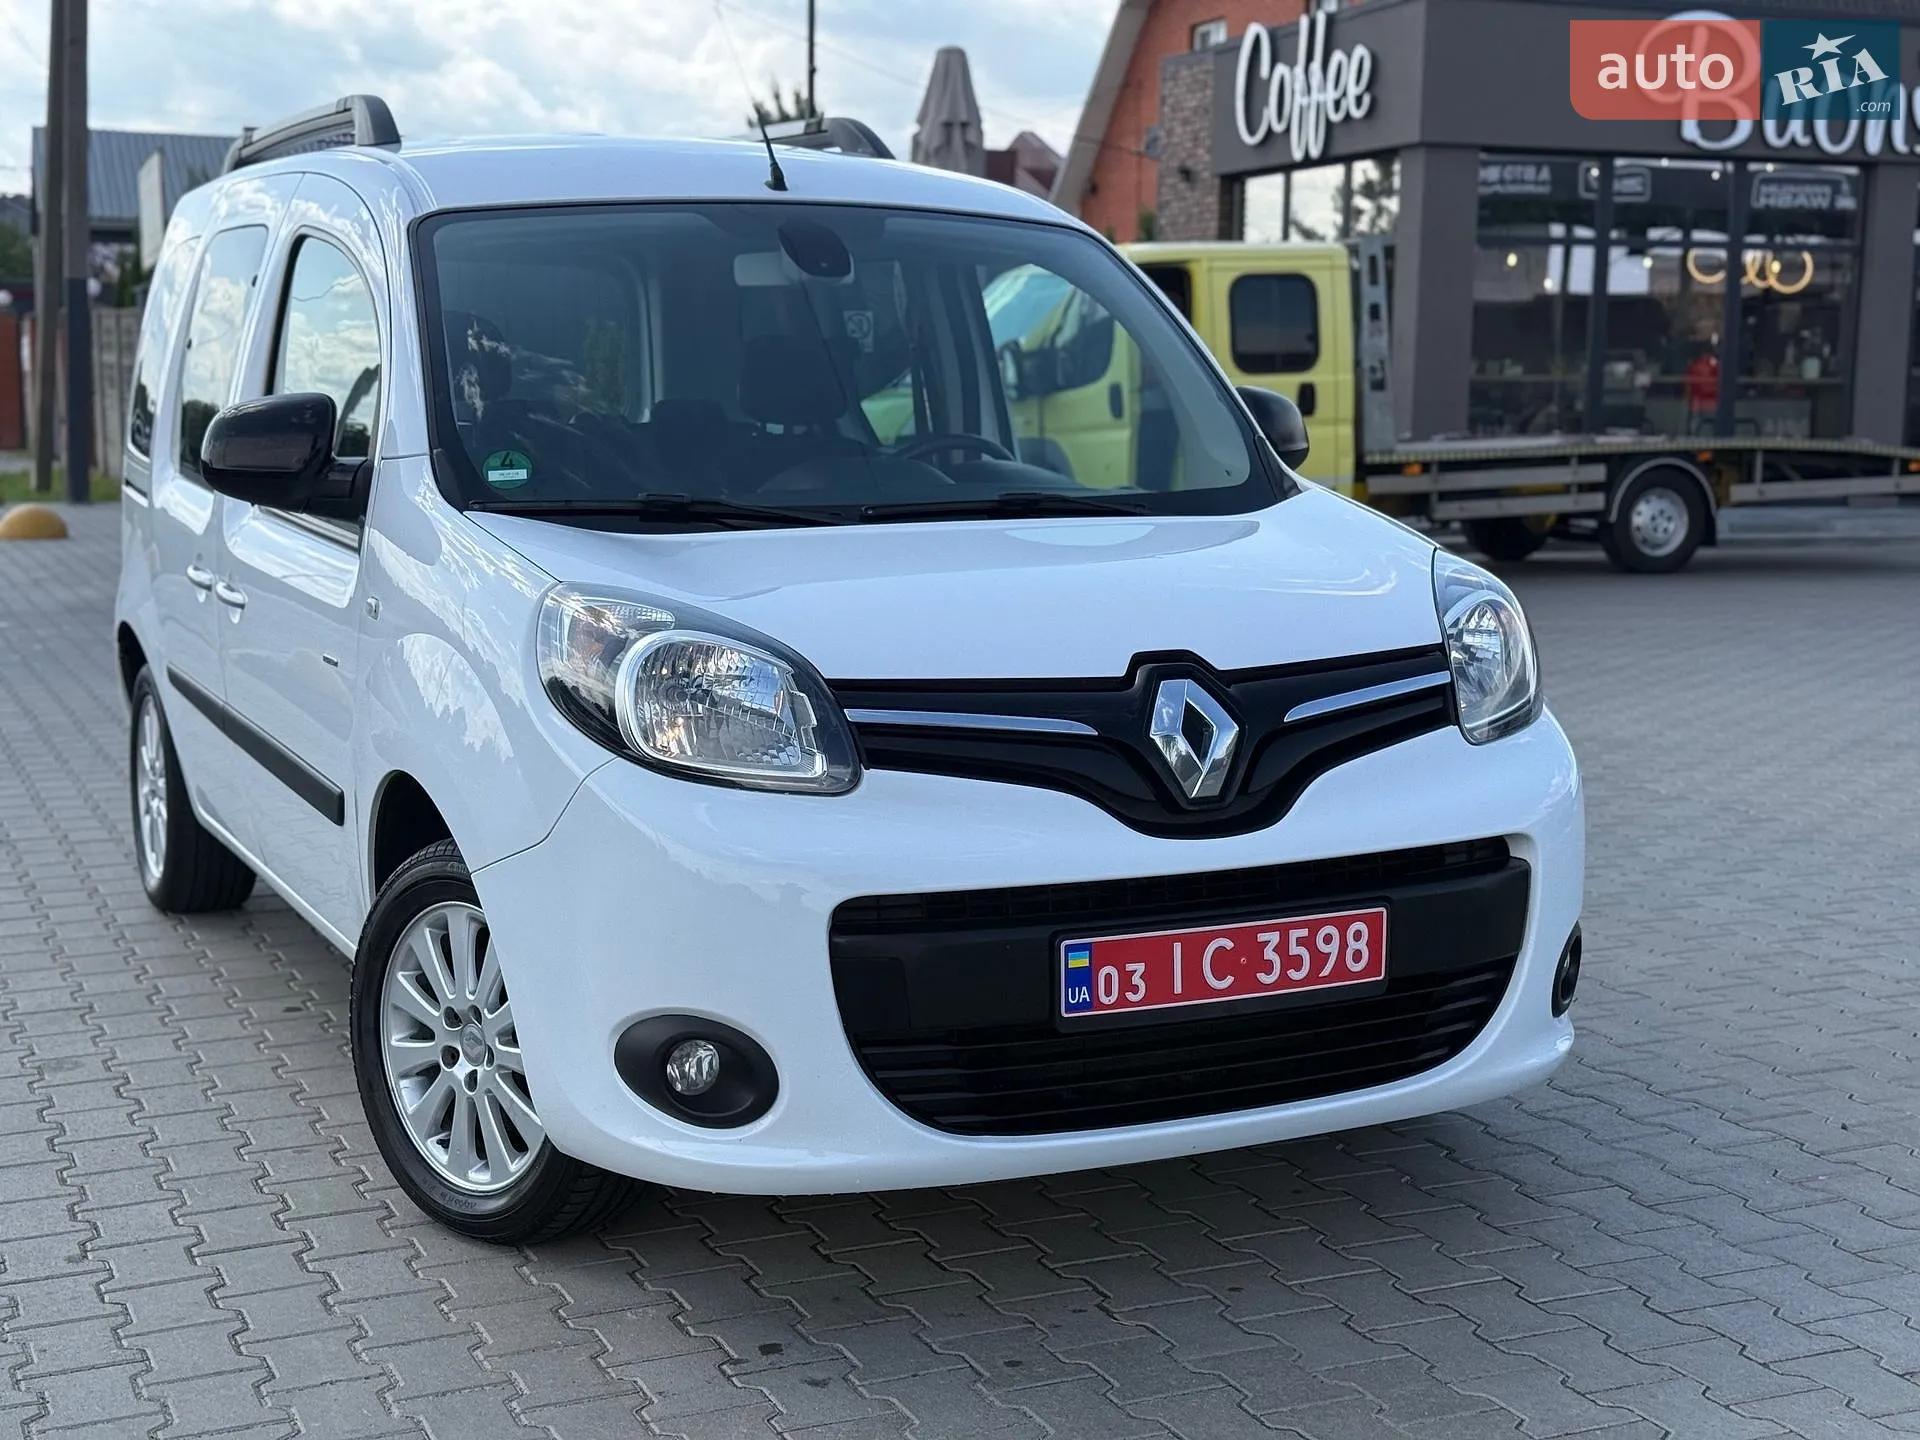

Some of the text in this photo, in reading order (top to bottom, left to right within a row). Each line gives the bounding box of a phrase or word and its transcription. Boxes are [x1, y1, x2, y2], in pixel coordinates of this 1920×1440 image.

[1234, 9, 1372, 162] Coffee
[500, 451, 515, 470] 4
[1098, 963, 1146, 1005] 03
[1256, 921, 1369, 984] 3598
[1068, 986, 1090, 1004] UA
